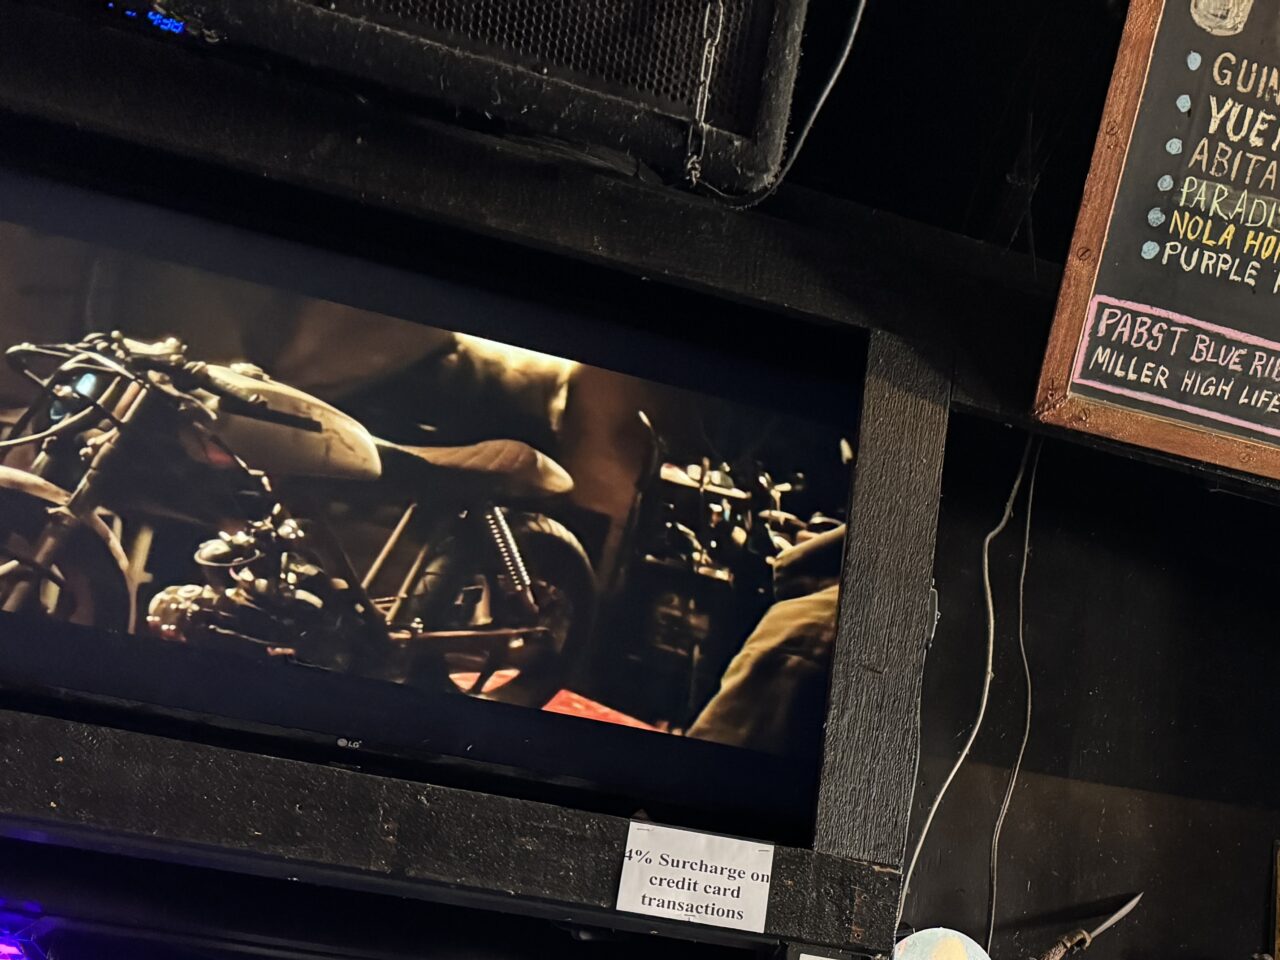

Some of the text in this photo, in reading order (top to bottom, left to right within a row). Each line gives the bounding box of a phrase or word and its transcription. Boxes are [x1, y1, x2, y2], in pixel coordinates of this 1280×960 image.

[1188, 137, 1279, 191] ABITA
[1169, 209, 1236, 249] NOLA
[1162, 241, 1261, 287] PURPLE
[1097, 307, 1188, 353] PABST
[1190, 334, 1243, 371] BLUE
[1088, 345, 1171, 389] MILLER
[1180, 370, 1235, 399] HIGH
[624, 848, 770, 883] 4% Surcharge on
[648, 872, 741, 899] credit card
[640, 892, 744, 920] transactions
